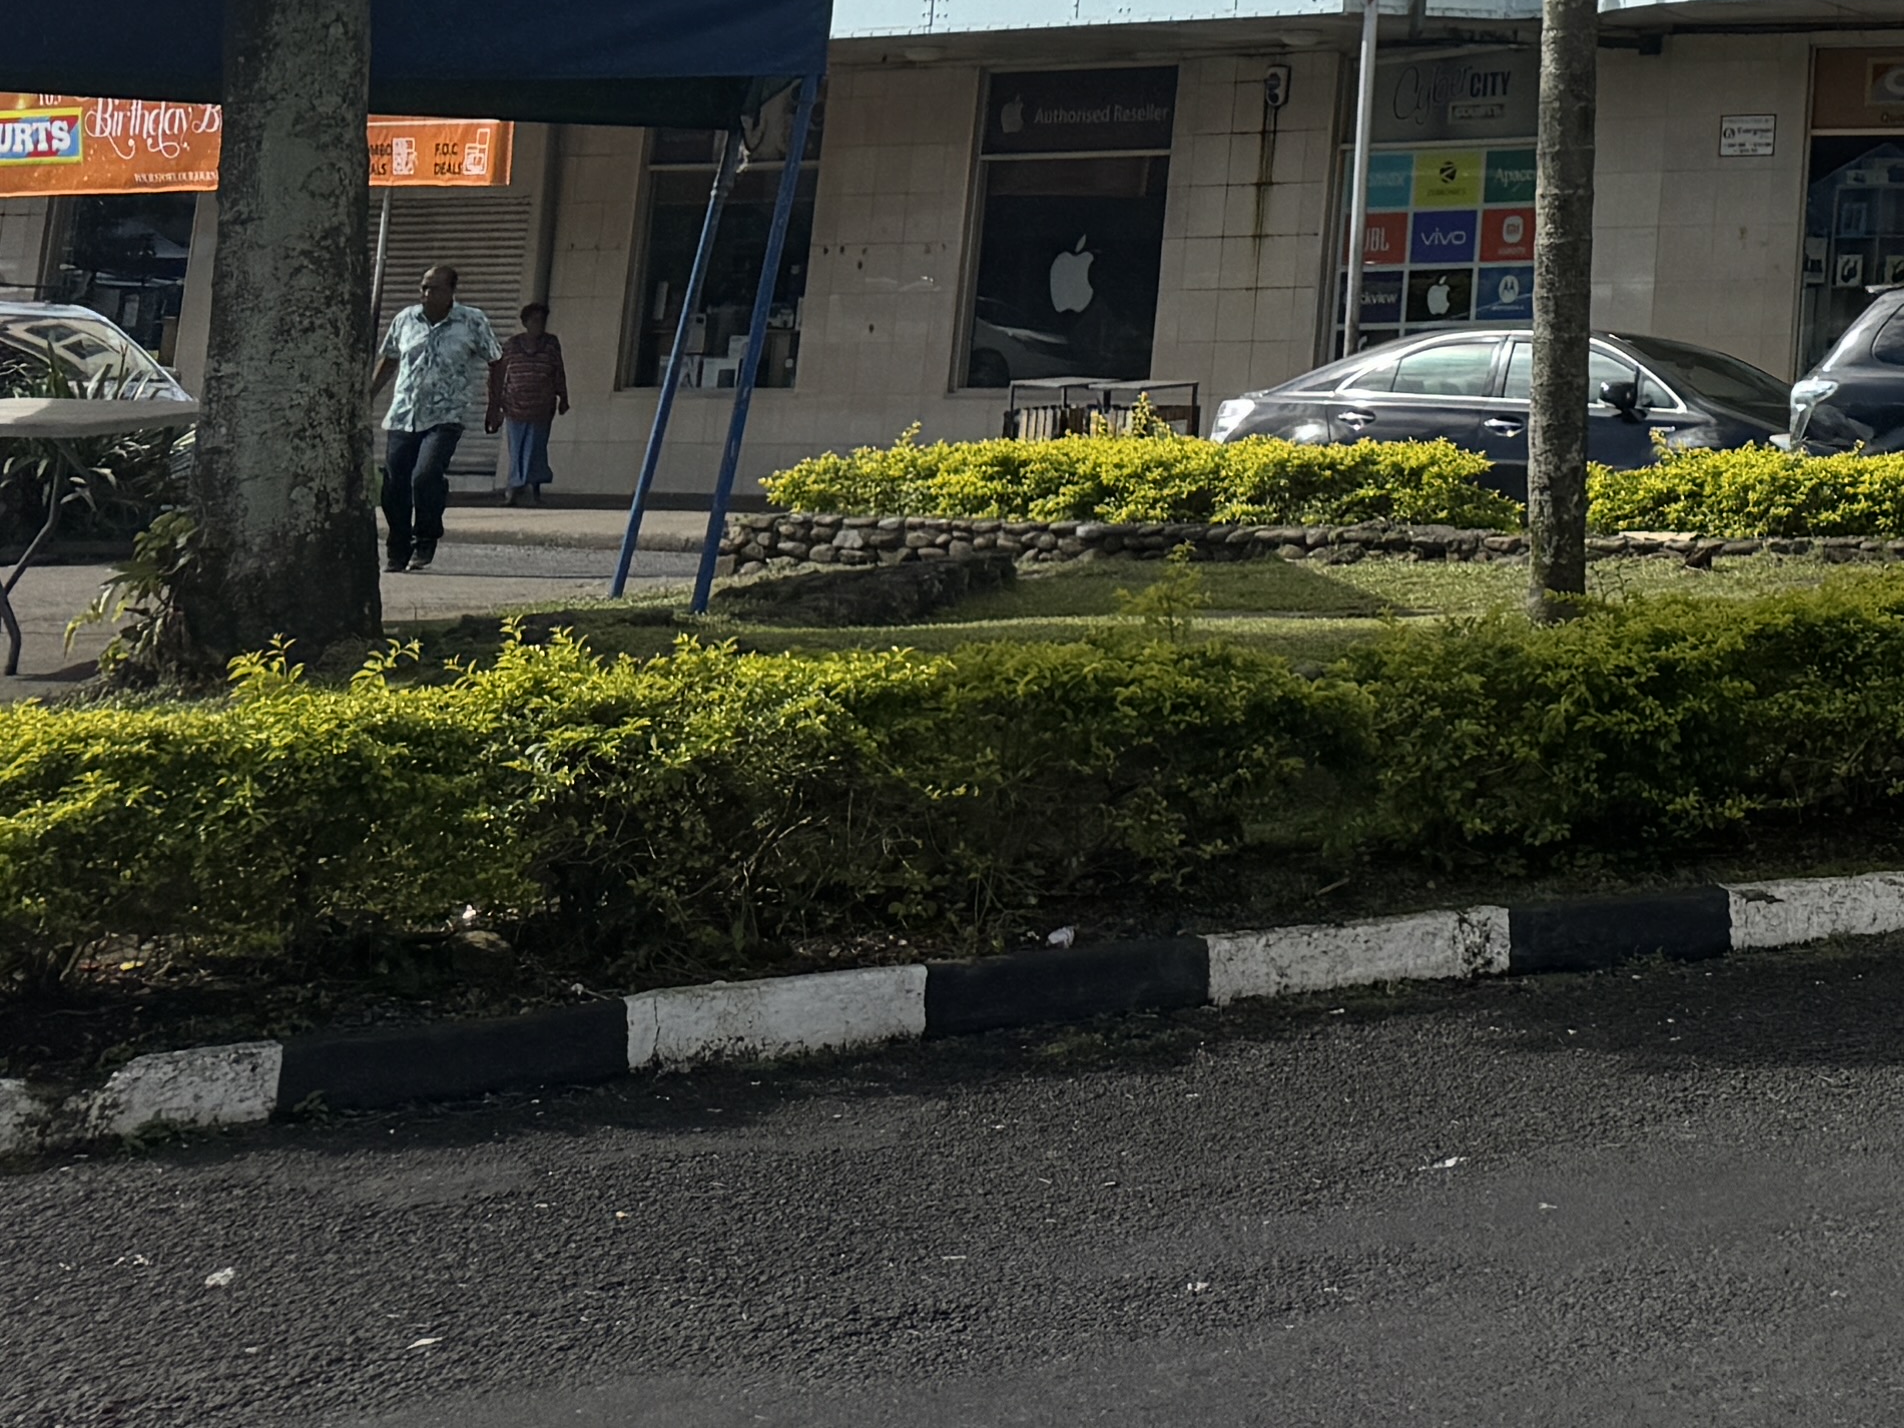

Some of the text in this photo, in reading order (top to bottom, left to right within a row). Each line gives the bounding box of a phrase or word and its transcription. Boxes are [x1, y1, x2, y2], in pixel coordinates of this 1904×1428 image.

[1033, 103, 1170, 124] Authorised Reseller
[85, 98, 192, 159] Birthday
[1420, 227, 1467, 245] vivo
